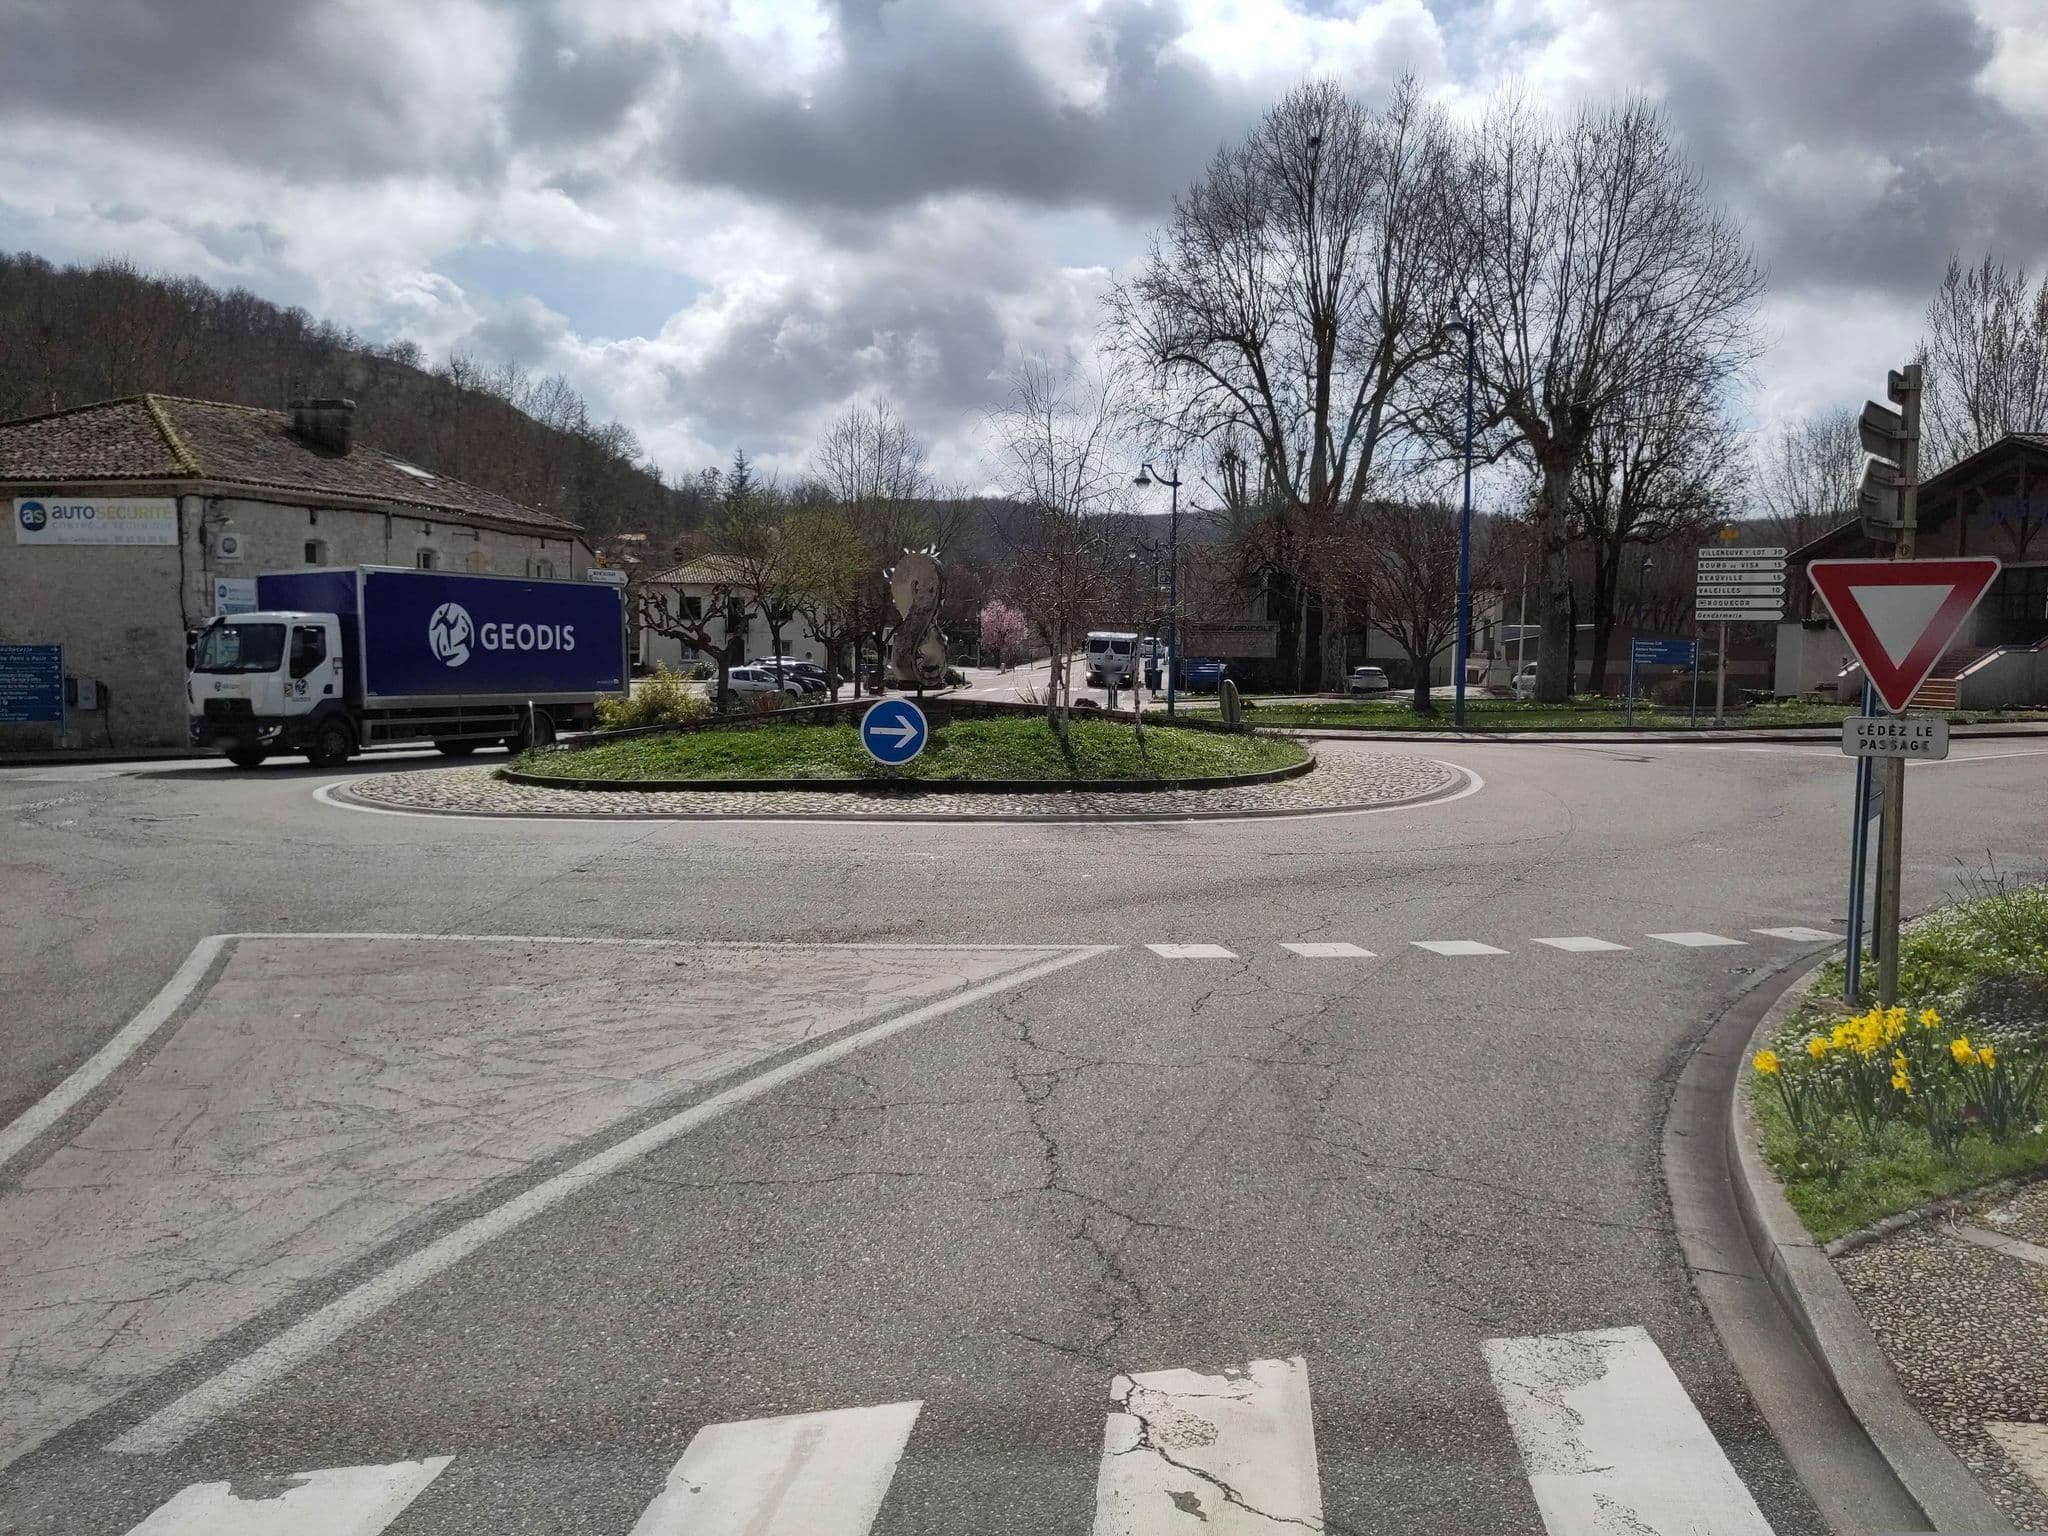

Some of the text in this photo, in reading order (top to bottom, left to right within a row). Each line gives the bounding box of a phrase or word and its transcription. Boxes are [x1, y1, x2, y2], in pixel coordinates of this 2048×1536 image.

[480, 622, 575, 651] GEODIS
[1916, 726, 1933, 737] LE
[1859, 739, 1931, 752] PASSAGE
